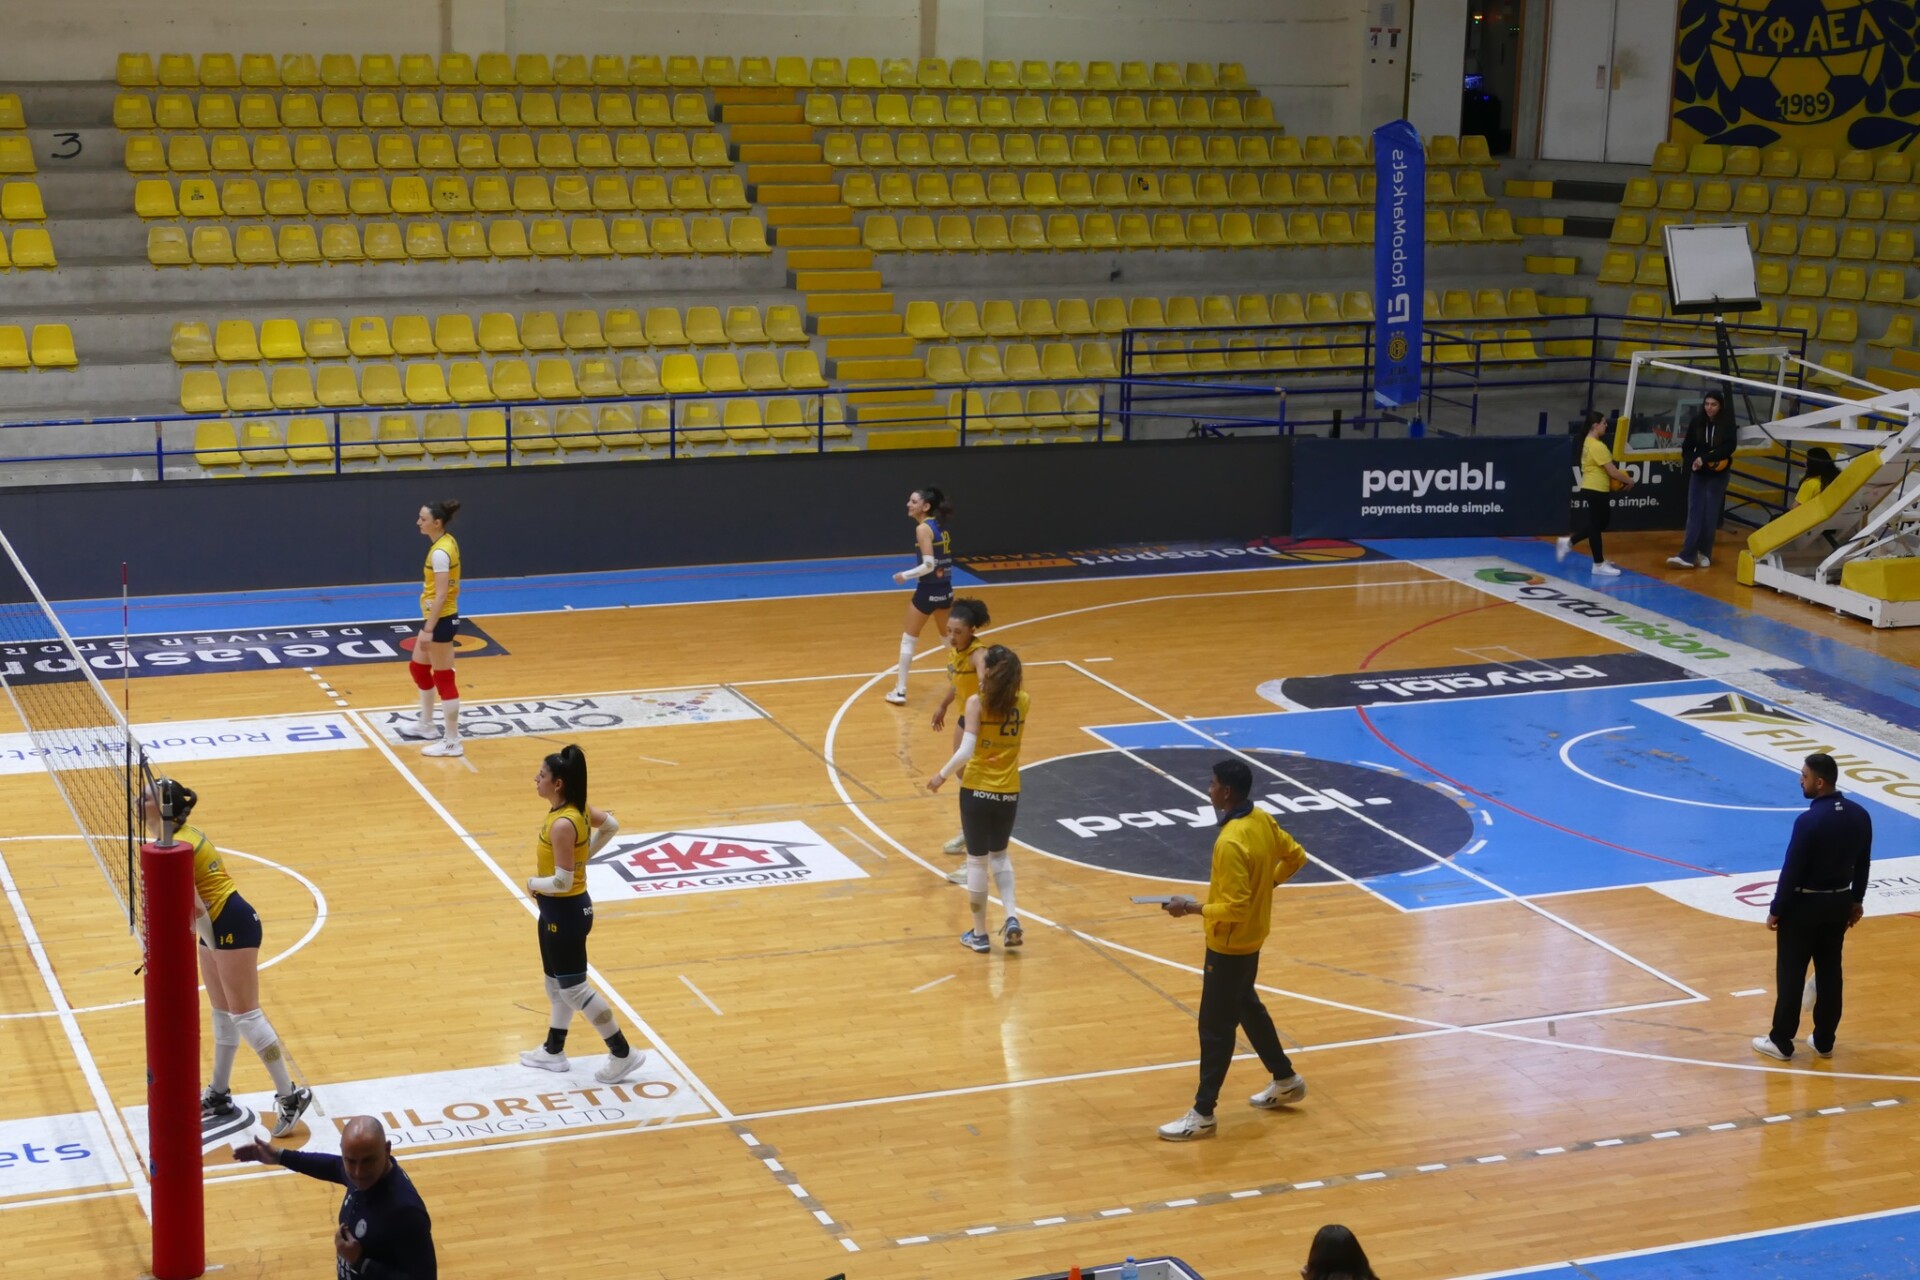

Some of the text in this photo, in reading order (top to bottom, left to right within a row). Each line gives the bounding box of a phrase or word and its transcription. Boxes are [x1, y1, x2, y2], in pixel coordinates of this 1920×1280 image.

[1779, 92, 1830, 117] 1989
[51, 132, 82, 159] 3
[1362, 462, 1506, 498] payabl.
[1361, 502, 1504, 516] payments made simple.
[1618, 496, 1660, 508] simple.
[1072, 546, 1281, 566] Delasport
[1517, 586, 1731, 660] cytavision
[161, 627, 362, 646] DELIVER
[1358, 664, 1608, 697] payabl.
[1000, 708, 1020, 737] 23
[972, 790, 1001, 802] ROYAL
[627, 840, 775, 874] EKA
[220, 933, 233, 945] 14
[556, 1107, 625, 1126] LTD
